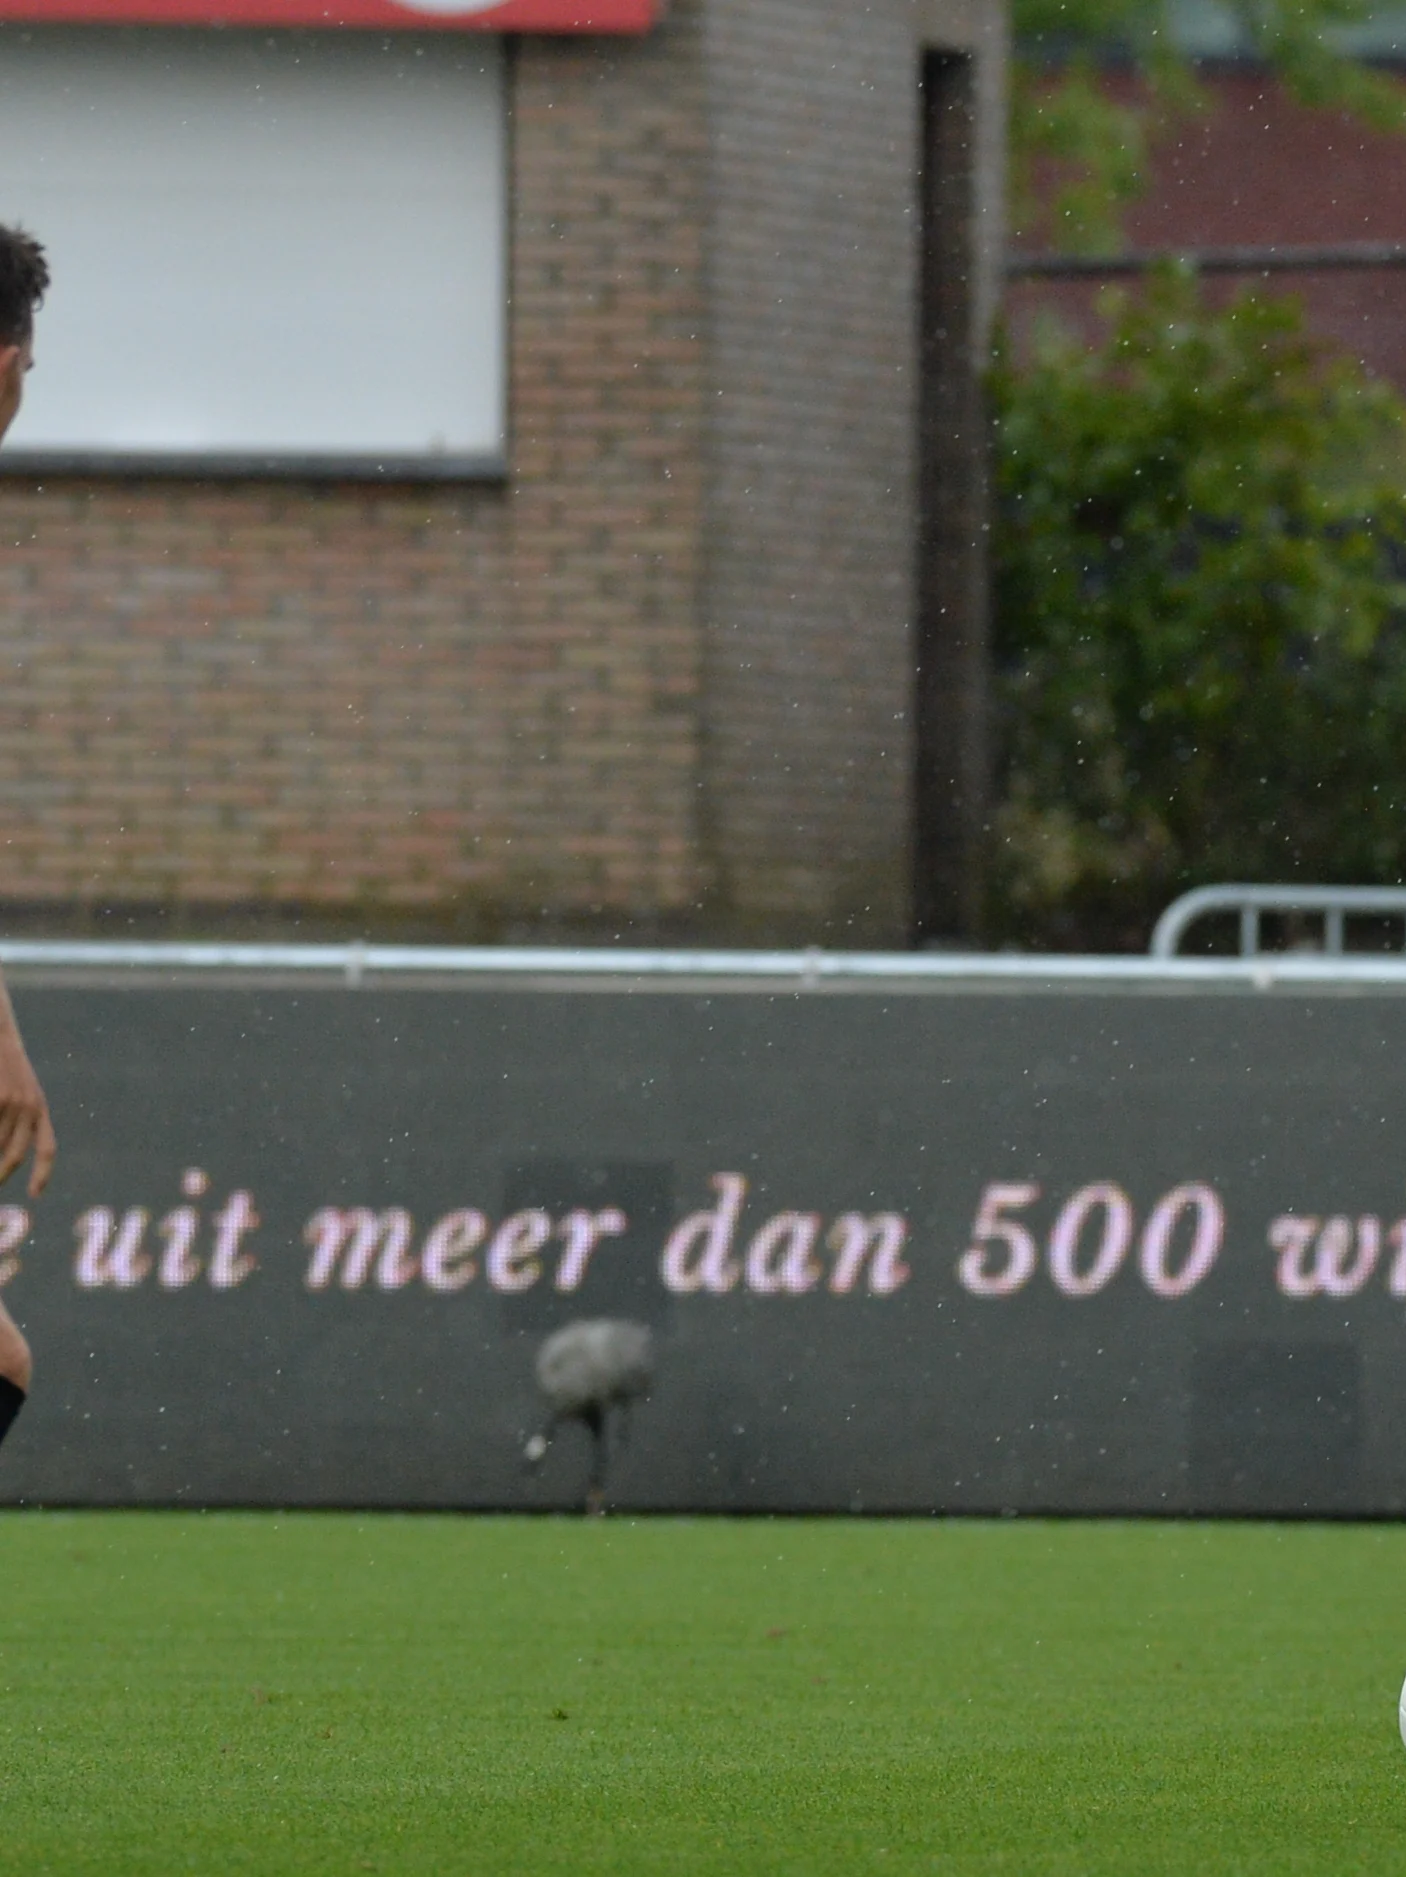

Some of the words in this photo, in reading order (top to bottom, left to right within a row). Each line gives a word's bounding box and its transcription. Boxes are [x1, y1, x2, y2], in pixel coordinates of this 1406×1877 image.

[76, 1166, 256, 1288] uit
[303, 1206, 625, 1291] meer
[661, 1172, 906, 1294] dan
[958, 1182, 1225, 1297] 500
